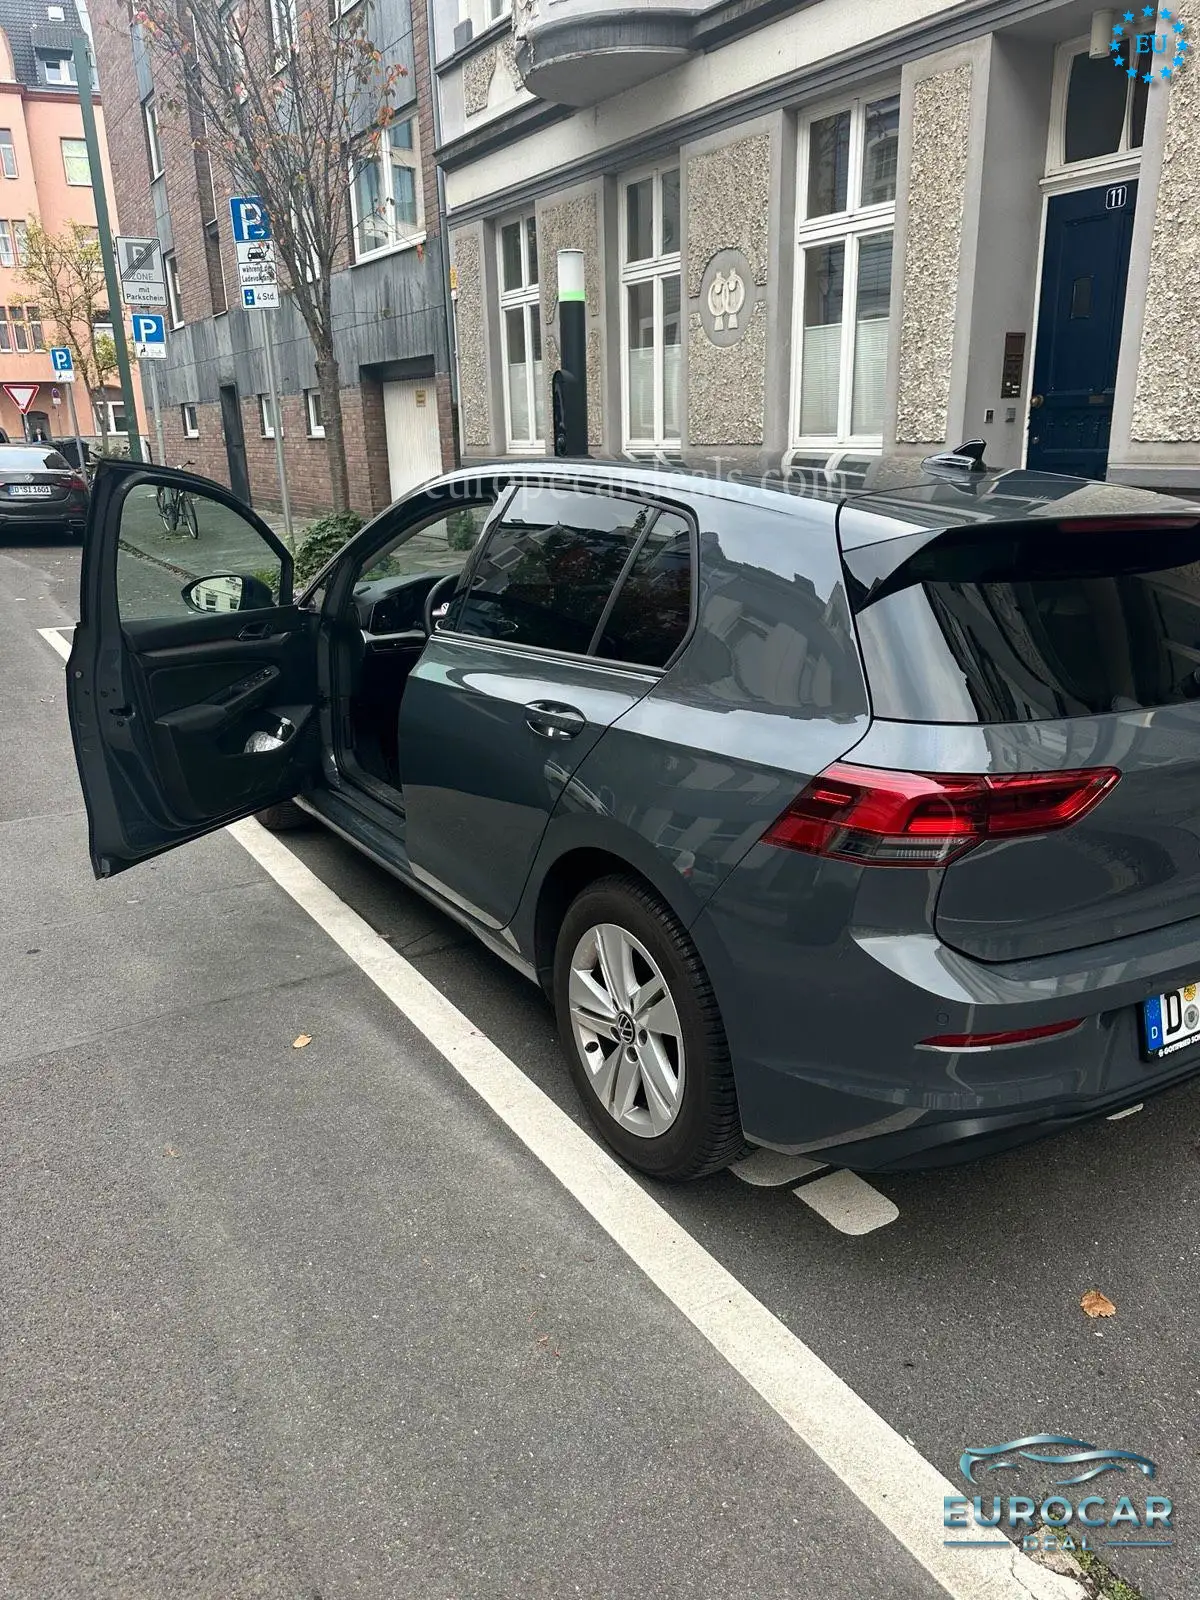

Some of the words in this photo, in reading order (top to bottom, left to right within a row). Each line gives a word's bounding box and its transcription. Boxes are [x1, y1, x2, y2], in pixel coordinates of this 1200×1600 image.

[1111, 189, 1122, 207] 11
[239, 203, 262, 240] P
[126, 293, 164, 301] Parkschein
[139, 318, 157, 343] P
[55, 351, 67, 370] P
[1164, 990, 1182, 1036] D
[1151, 1026, 1158, 1040] D
